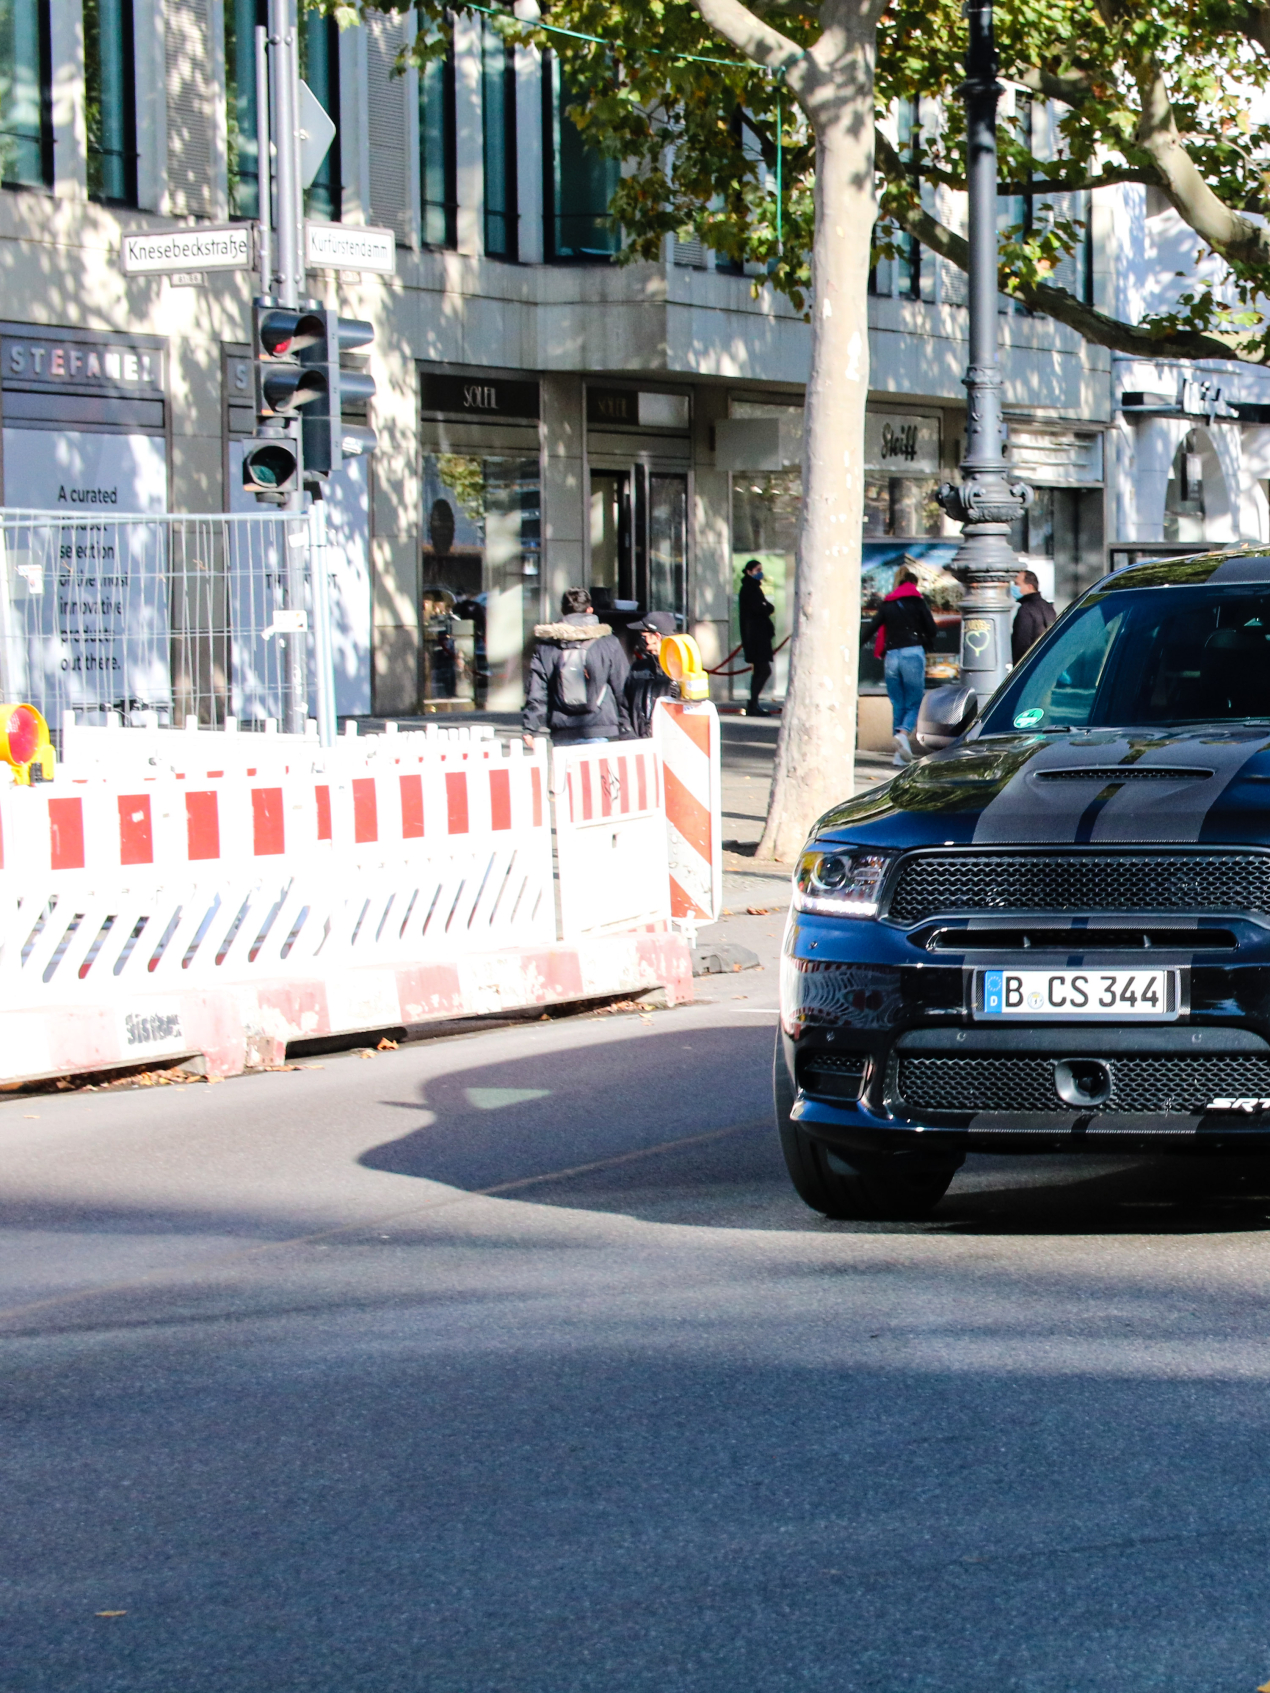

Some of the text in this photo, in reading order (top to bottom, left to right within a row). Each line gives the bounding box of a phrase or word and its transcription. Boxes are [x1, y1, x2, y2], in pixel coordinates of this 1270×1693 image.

[128, 234, 247, 261] Knesebeckstraße
[311, 231, 388, 259] Kurfürstendamm
[10, 345, 156, 382] STEFANEL
[881, 422, 918, 462] Steiff
[58, 485, 118, 504] A curated
[59, 541, 115, 560] seection
[989, 996, 998, 1007] D
[1005, 976, 1159, 1008] B CS 344
